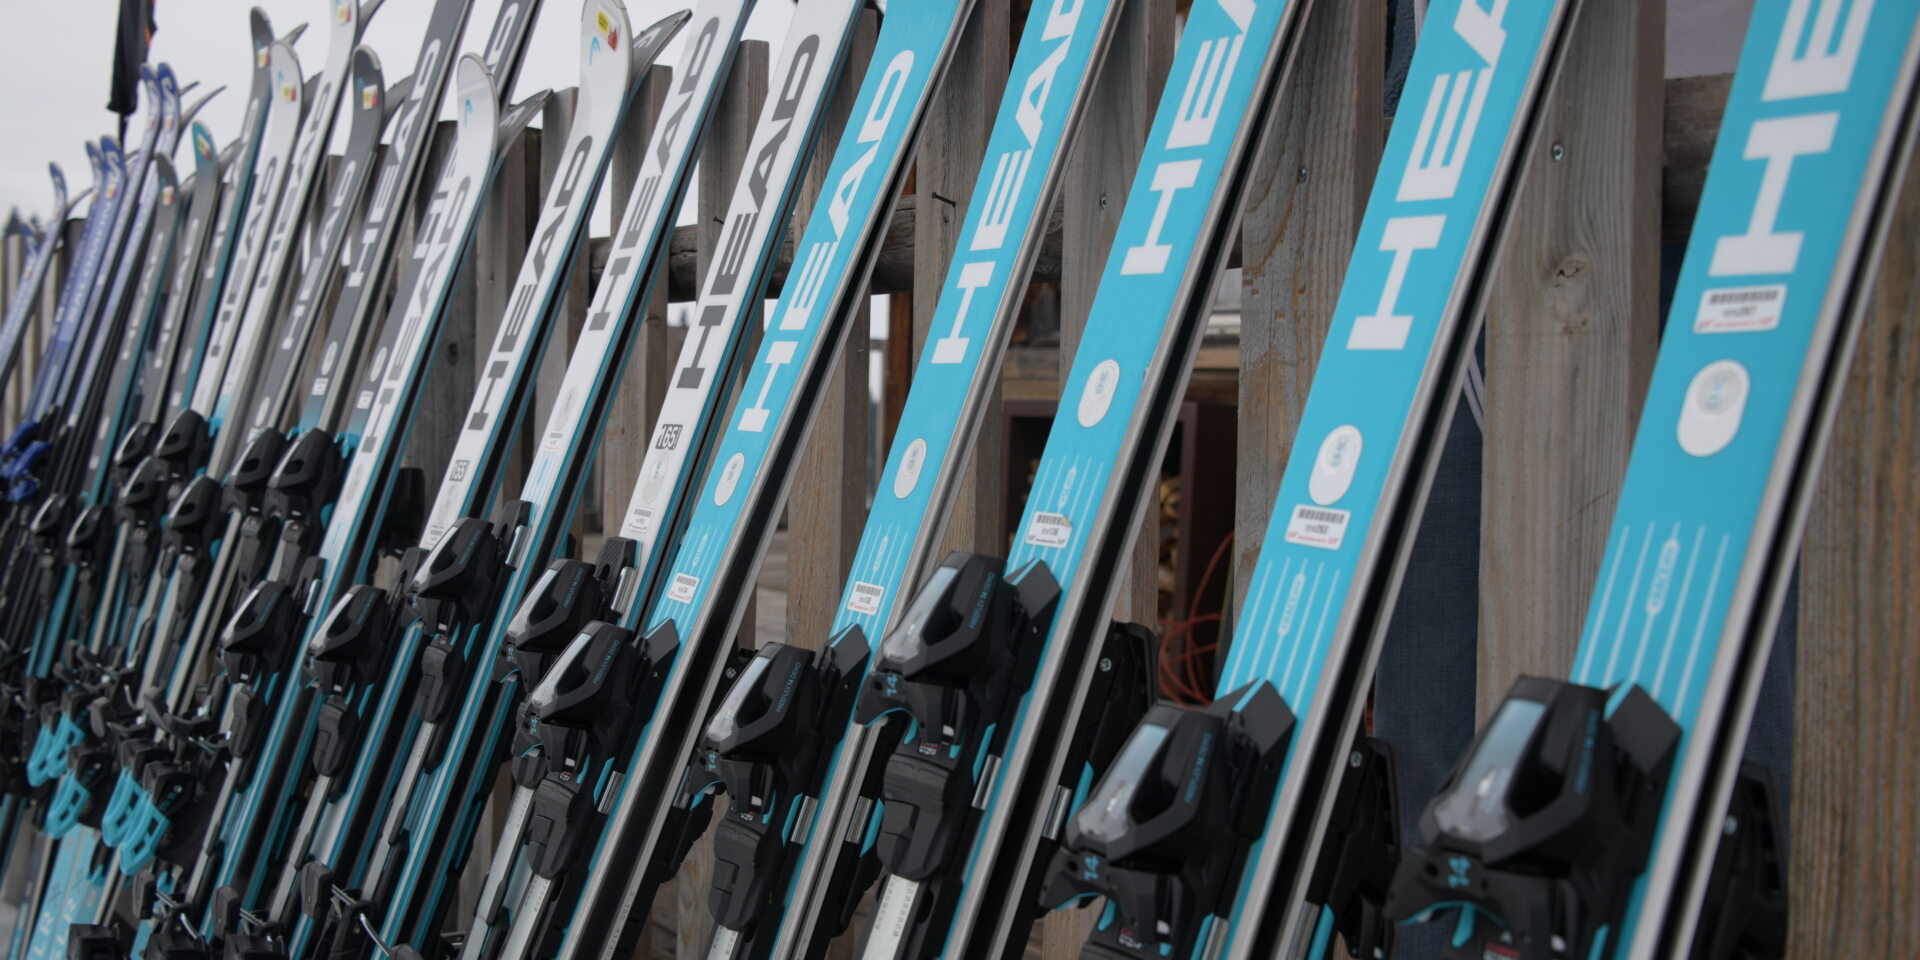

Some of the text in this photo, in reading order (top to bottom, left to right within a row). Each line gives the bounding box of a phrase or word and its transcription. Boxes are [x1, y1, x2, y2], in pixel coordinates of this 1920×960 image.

[210, 156, 278, 358] HEAD
[258, 82, 332, 289] HEAD
[282, 161, 357, 350] HEAD
[347, 38, 442, 287] HEAD
[588, 17, 720, 331] HEAD
[677, 34, 820, 389] HEAD
[737, 49, 915, 432] HEAD
[1120, 0, 1257, 275] HE
[361, 175, 472, 454] HEAD
[467, 135, 593, 431] HEAD
[886, 674, 898, 696] 14
[1084, 856, 1099, 880] 14
